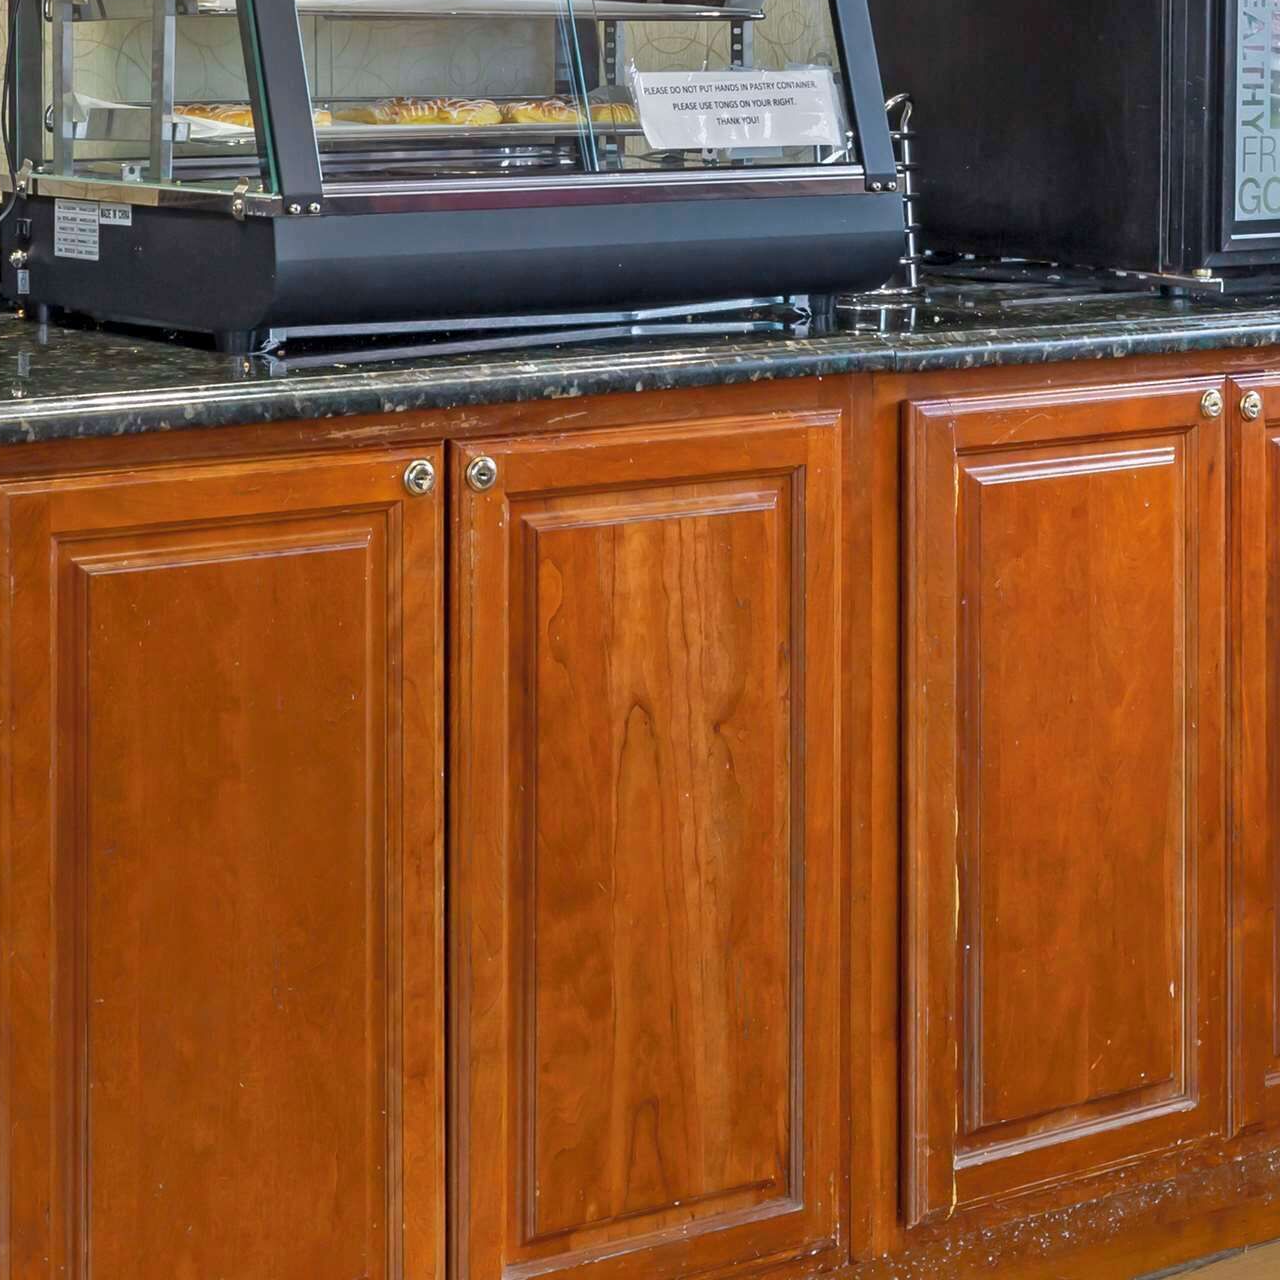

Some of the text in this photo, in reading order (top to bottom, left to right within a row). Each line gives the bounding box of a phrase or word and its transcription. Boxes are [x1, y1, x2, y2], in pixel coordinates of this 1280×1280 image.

[643, 87, 669, 95] PLEASE
[670, 86, 681, 94] DO
[682, 85, 698, 94] NOT
[700, 85, 713, 93] PUT
[715, 84, 739, 92] HANDS
[740, 83, 748, 91] IN
[749, 82, 776, 91] PASTRY
[673, 102, 698, 111] PLEASE
[699, 101, 713, 110] USE
[715, 100, 739, 109] TONGS
[739, 100, 750, 108] ON
[752, 99, 771, 108] YOUR
[716, 117, 740, 125] THANK
